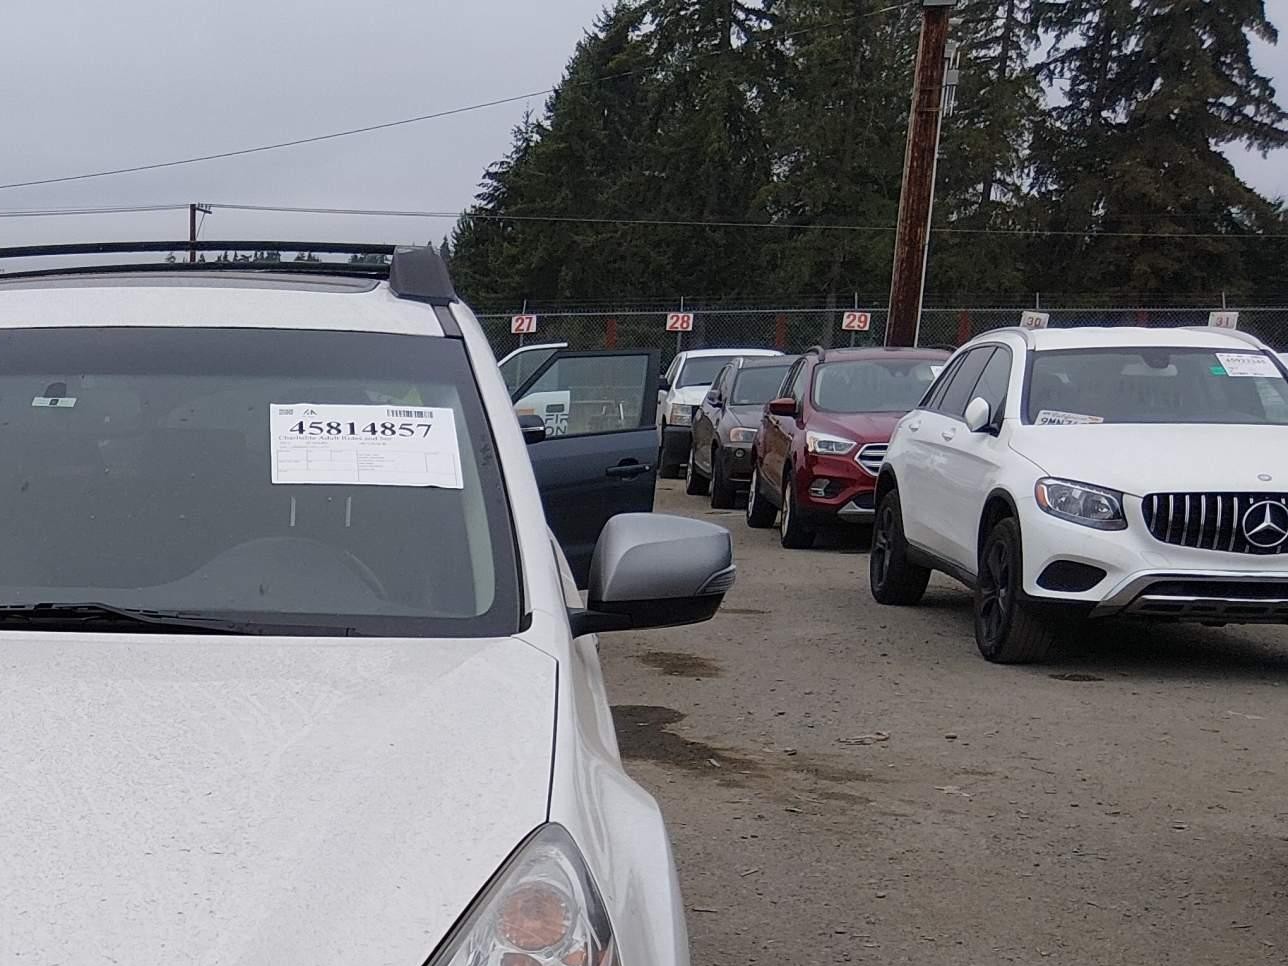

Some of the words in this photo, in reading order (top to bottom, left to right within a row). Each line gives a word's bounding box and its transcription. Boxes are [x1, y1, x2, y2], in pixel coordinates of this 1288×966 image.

[515, 316, 533, 332] 27
[669, 314, 691, 330] 28
[845, 313, 869, 329] 29
[1027, 316, 1042, 327] 30
[1216, 316, 1230, 327] 31
[290, 420, 432, 438] 45814857
